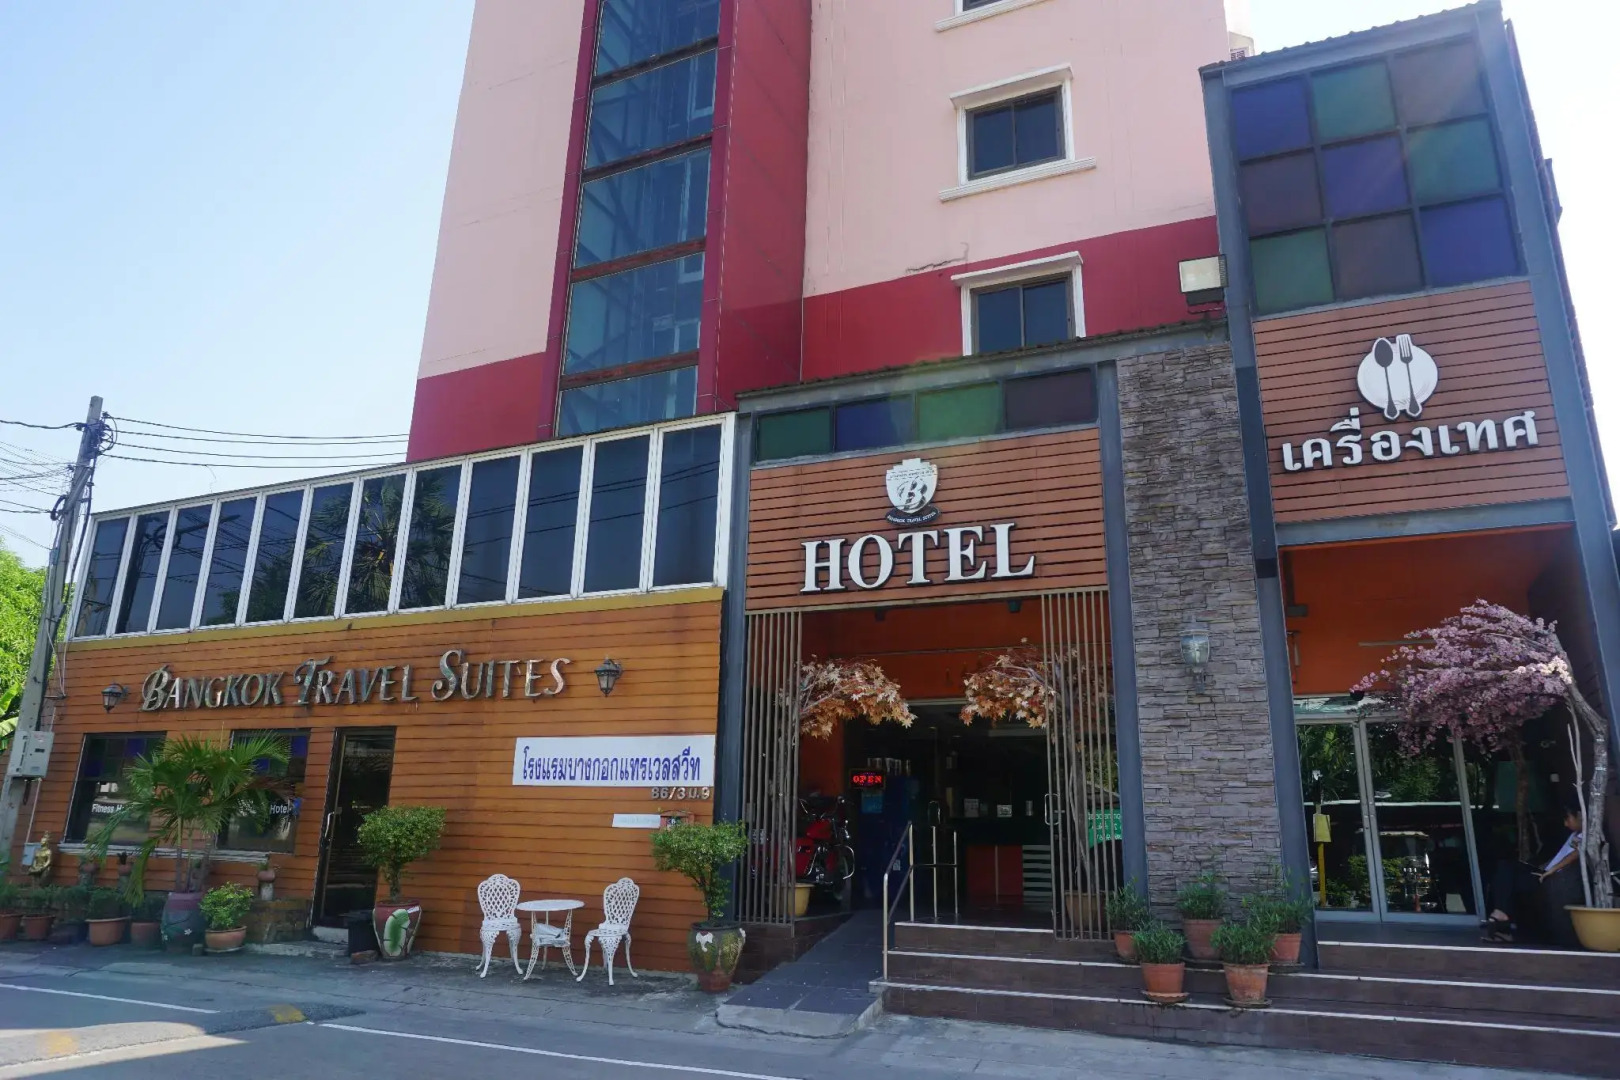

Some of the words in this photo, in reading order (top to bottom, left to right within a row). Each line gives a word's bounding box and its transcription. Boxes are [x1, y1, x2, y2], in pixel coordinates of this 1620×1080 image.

[1282, 408, 1539, 472] เครื่องเทศ
[800, 523, 1036, 593] HOTEL
[140, 665, 284, 712] BANGKOK
[294, 657, 419, 704] TRAVEL
[432, 649, 570, 701] SUITES
[522, 746, 700, 781] โรงแรมบางกอกแทรเวลสวีท
[852, 775, 882, 784] OPEN
[91, 803, 115, 813] Fitness
